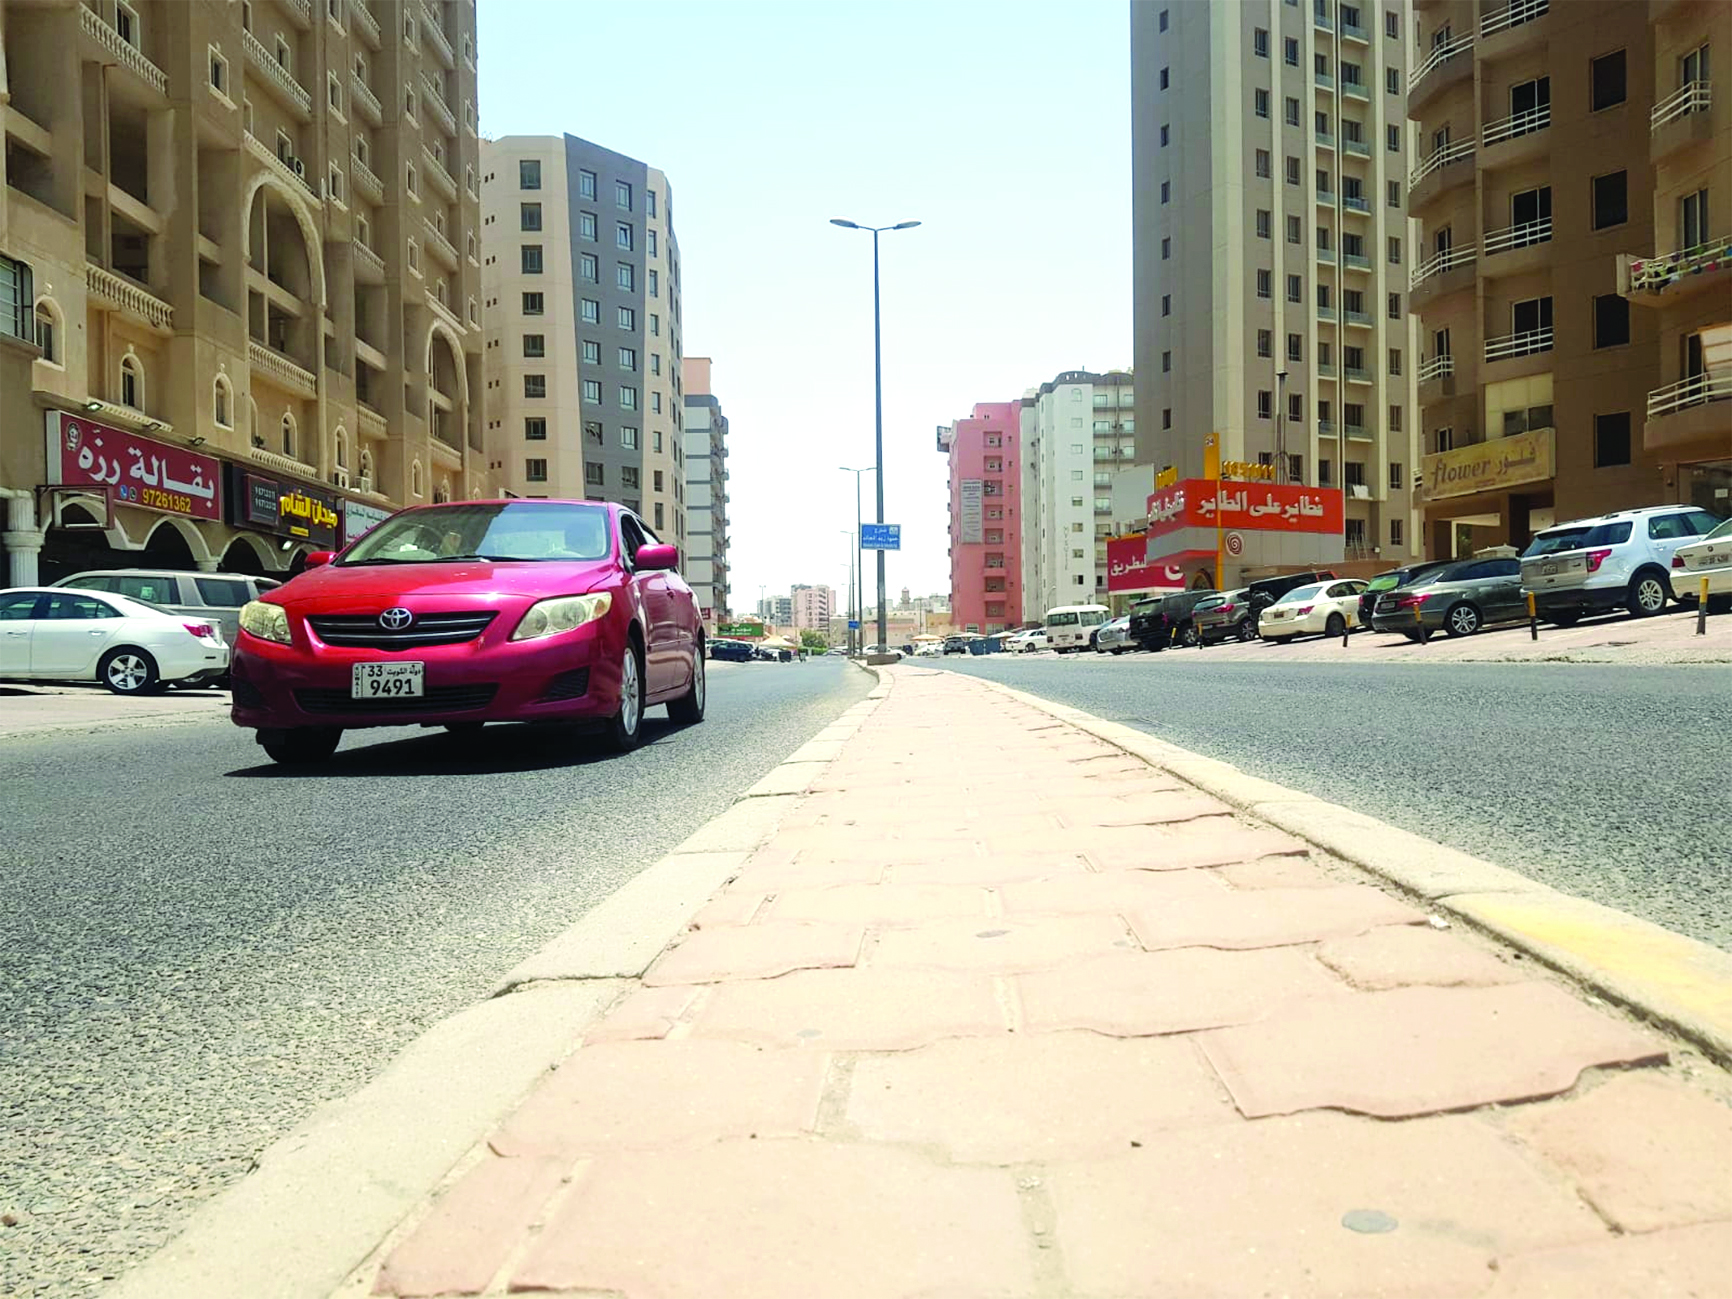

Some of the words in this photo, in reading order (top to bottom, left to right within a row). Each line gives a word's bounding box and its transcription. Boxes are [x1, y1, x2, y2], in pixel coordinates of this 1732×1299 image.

[1497, 441, 1536, 476] فلور
[129, 447, 214, 509] بقالة
[1430, 459, 1491, 490] flower
[142, 490, 192, 513] 97261362
[279, 489, 311, 517] الشام
[1196, 490, 1248, 519] الطاير
[1250, 493, 1281, 517] على
[1110, 553, 1147, 577] لبطريق
[367, 665, 383, 677] 33
[370, 679, 415, 696] 9491
